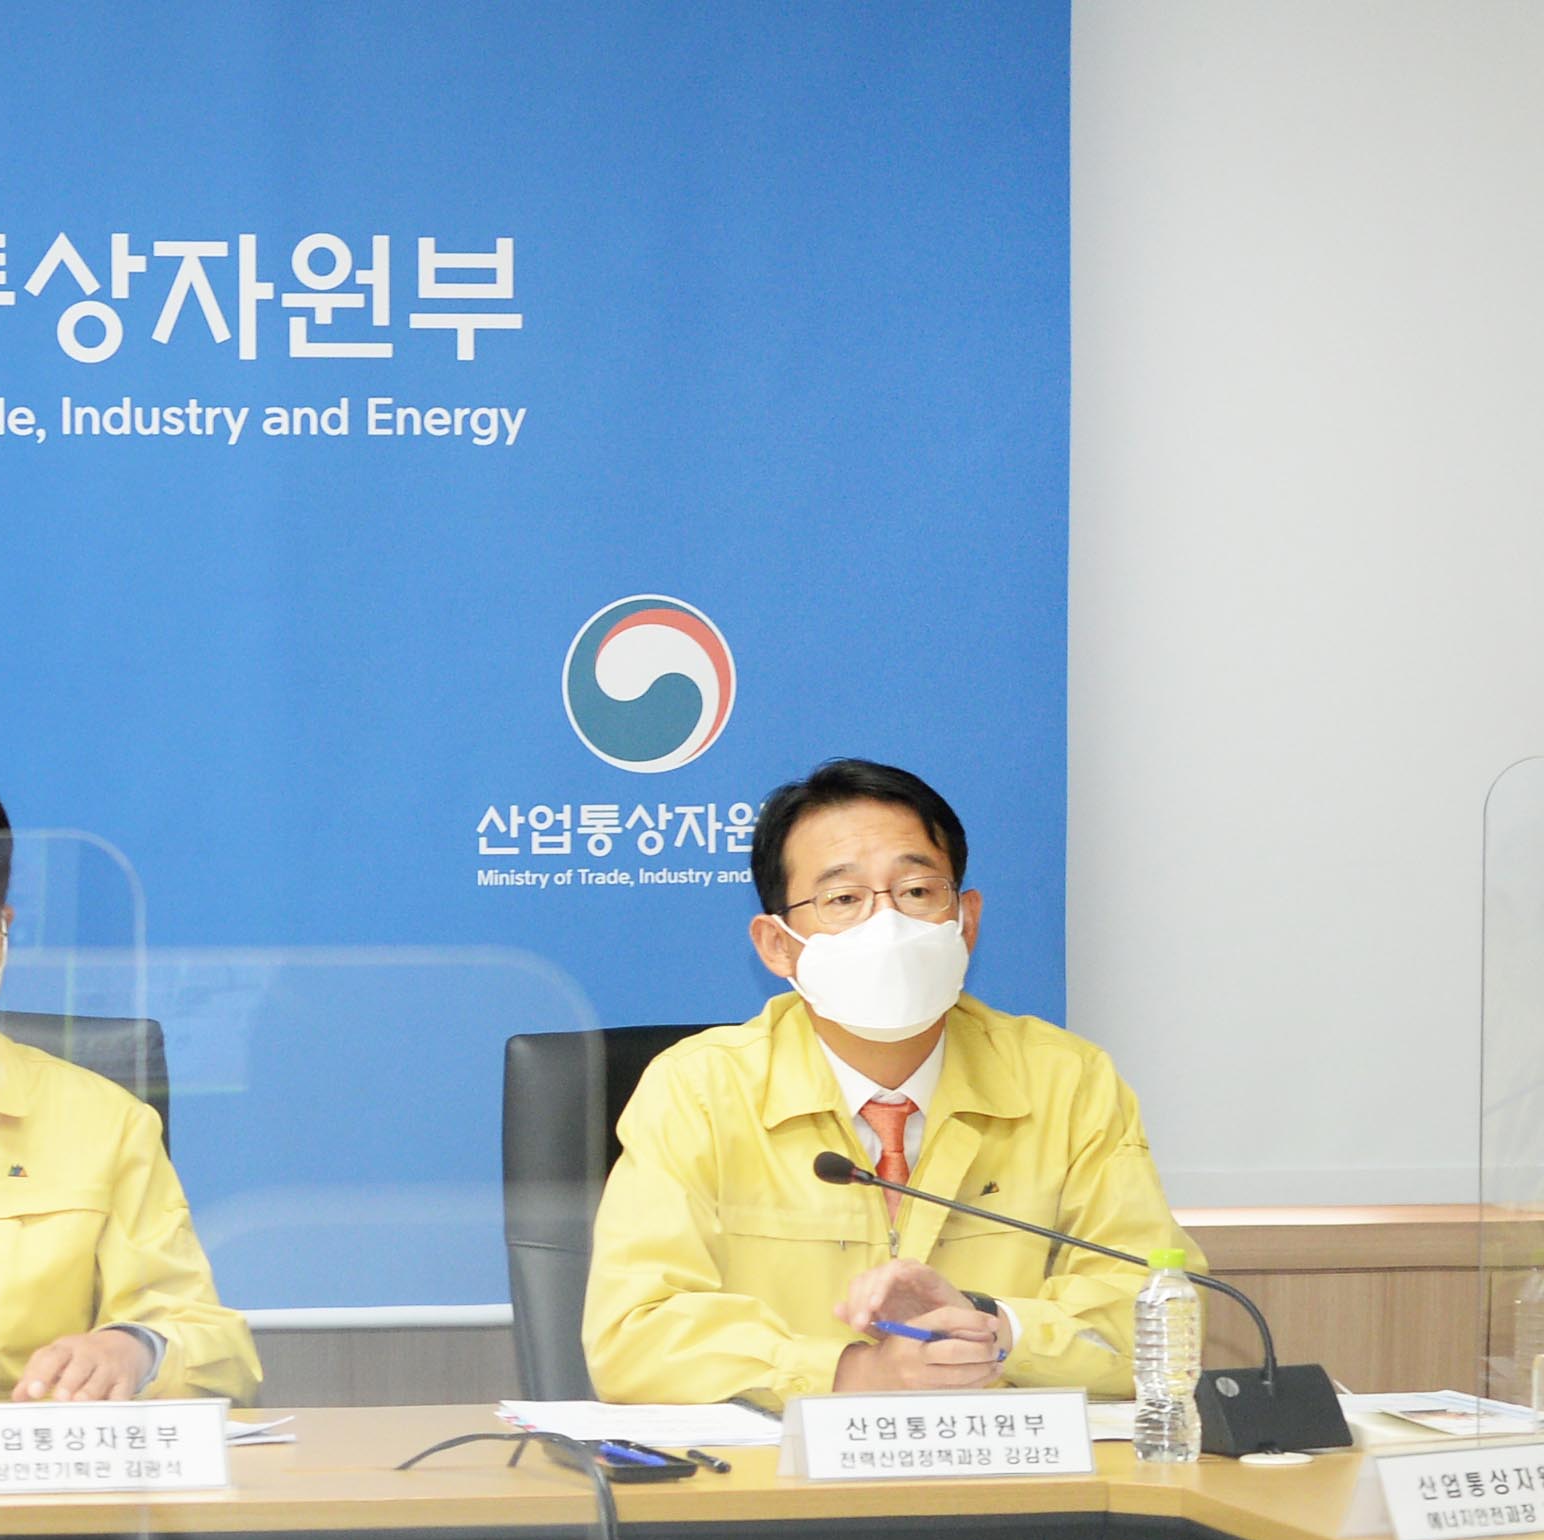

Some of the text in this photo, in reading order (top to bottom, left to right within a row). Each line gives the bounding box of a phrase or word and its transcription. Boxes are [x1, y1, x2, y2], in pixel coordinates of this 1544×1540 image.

[62, 396, 249, 445] Industry
[262, 397, 349, 437] and
[367, 397, 526, 446] Energy
[477, 867, 753, 889] Ministry of Trade, Industry and
[845, 1413, 1047, 1442] 산업통상자원부
